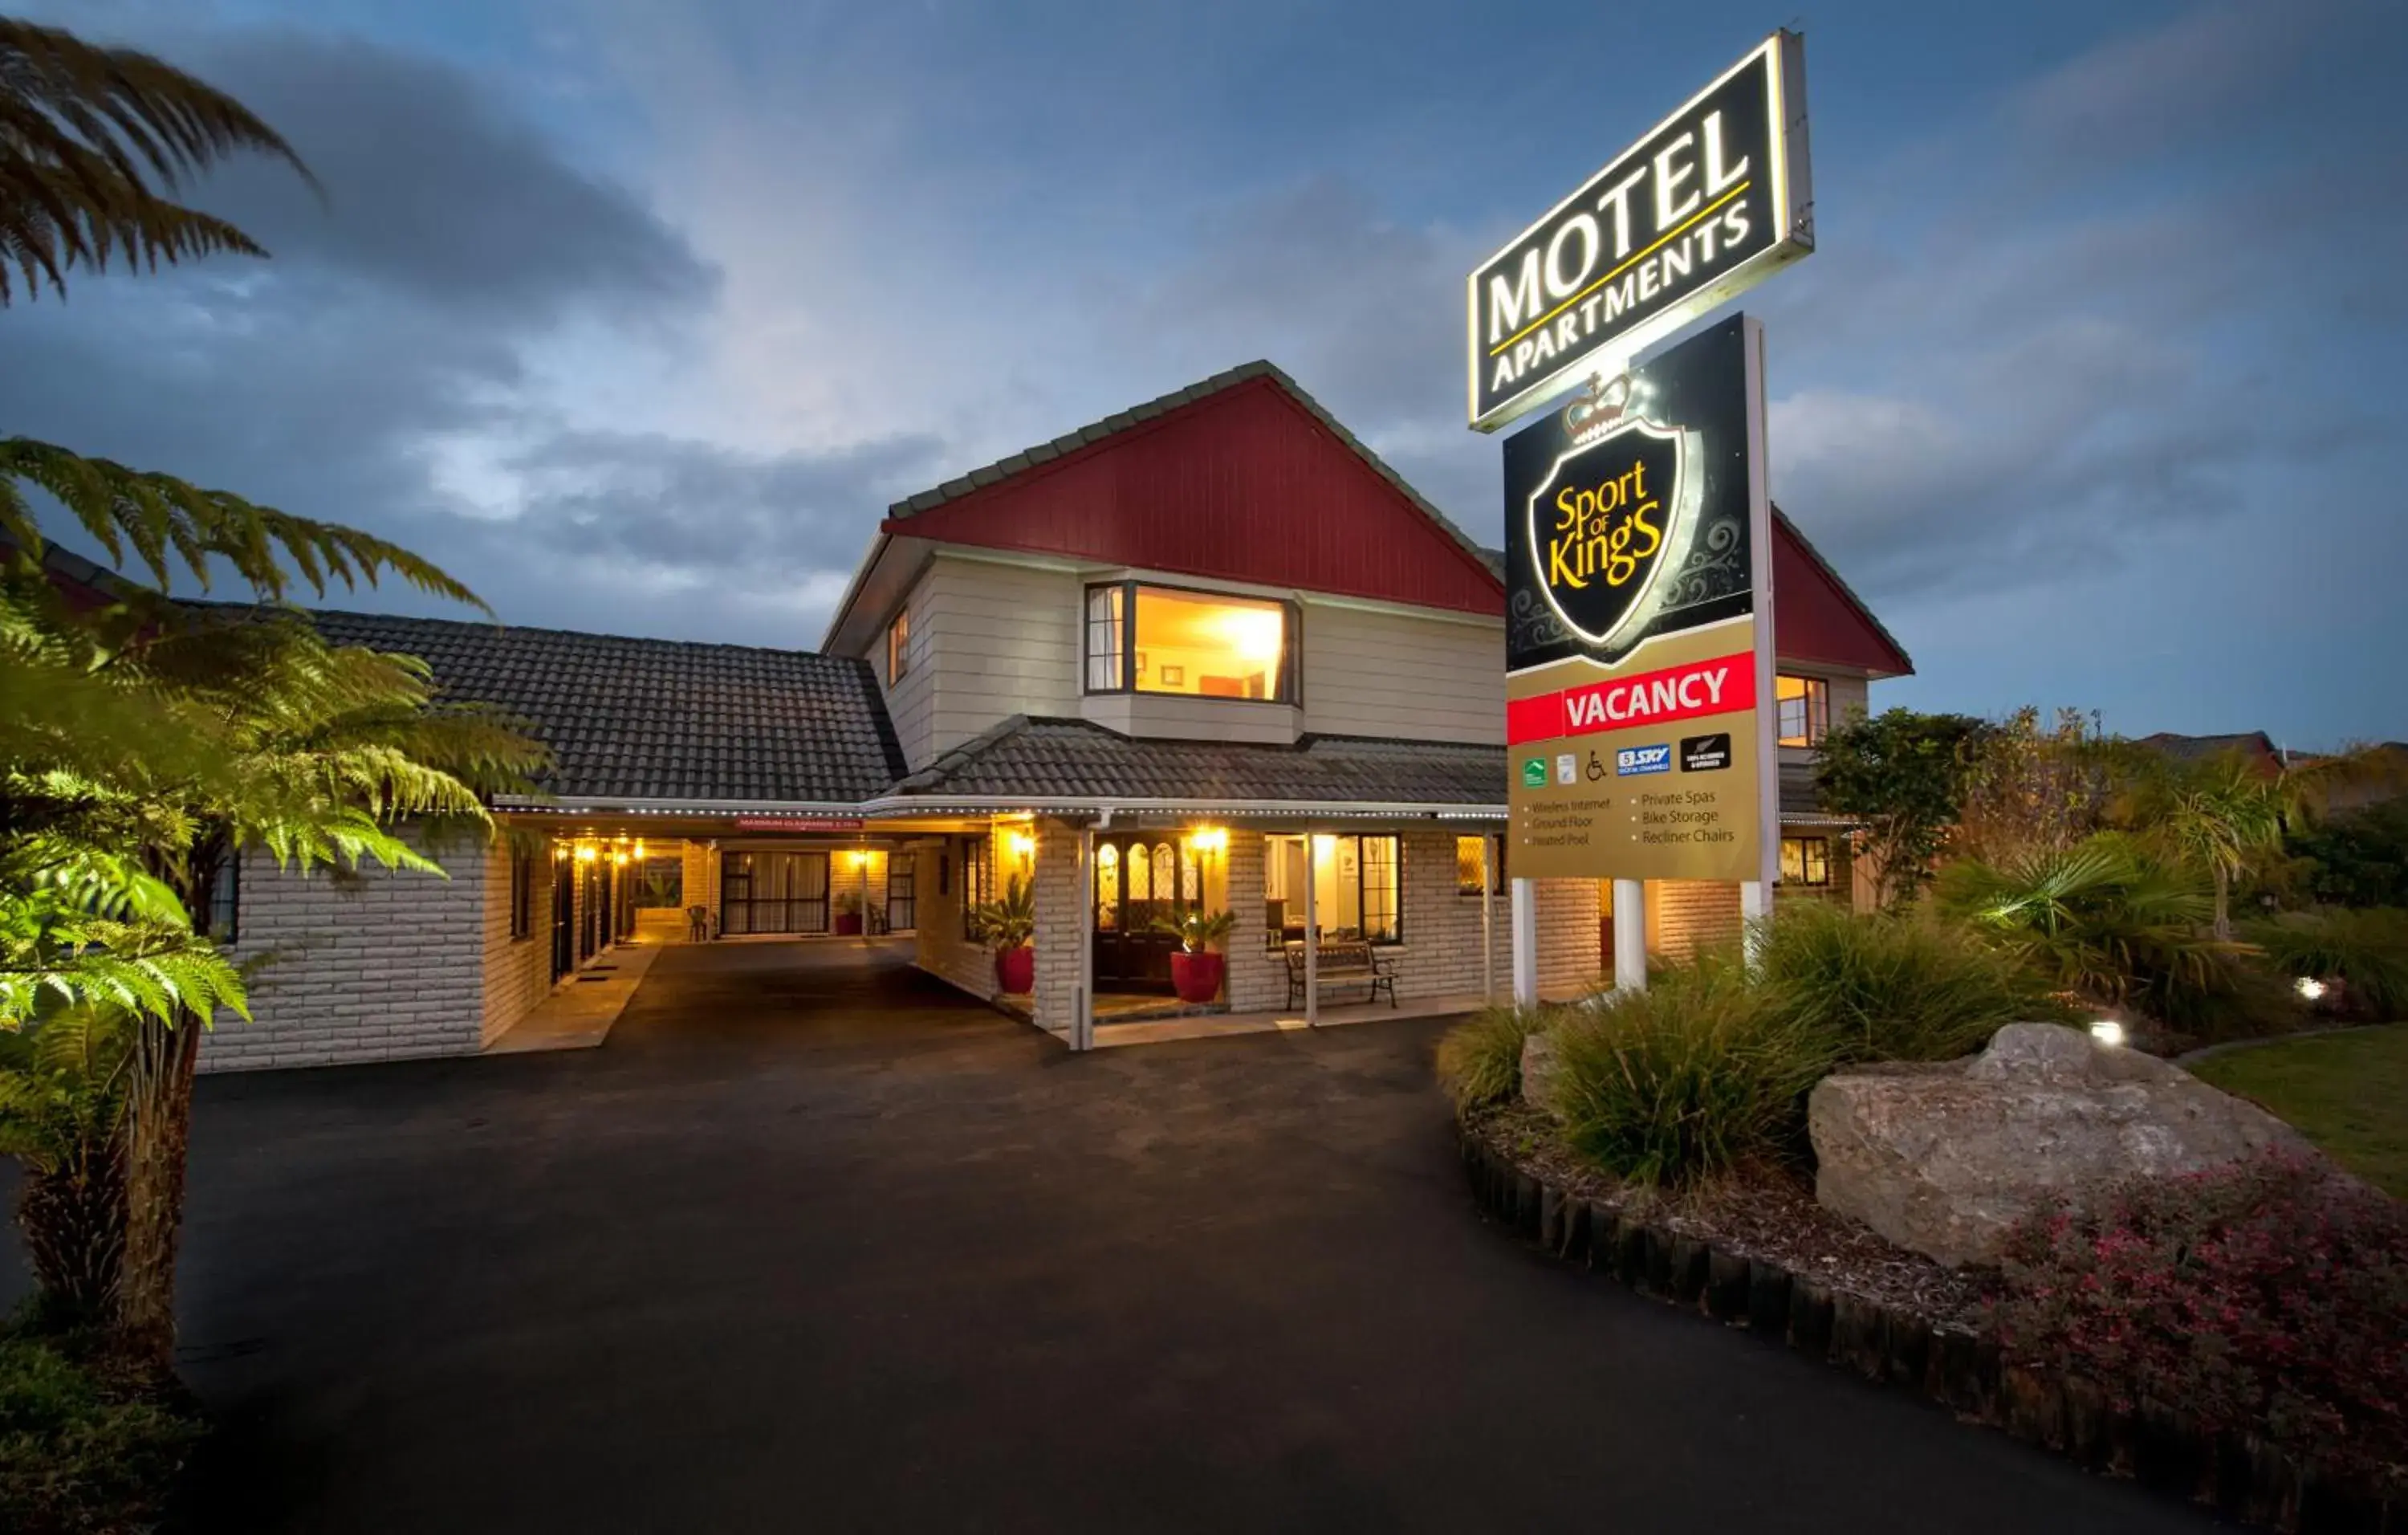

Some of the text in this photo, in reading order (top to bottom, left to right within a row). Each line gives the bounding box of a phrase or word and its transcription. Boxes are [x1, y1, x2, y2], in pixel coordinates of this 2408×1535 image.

[1489, 108, 1751, 345] MOTEL
[1491, 198, 1751, 393] APARTMENTS
[1556, 459, 1648, 539] Sport
[1566, 667, 1728, 727] VACANCY
[1635, 747, 1669, 764] SKY
[1532, 798, 1610, 813] Wireless Internet
[1641, 790, 1716, 805] Private Spas
[1532, 816, 1592, 829] Ground Floor
[1642, 809, 1719, 825] Bike Storage
[1568, 833, 1590, 845] Pool
[1642, 828, 1735, 844] Recliner Chairs
